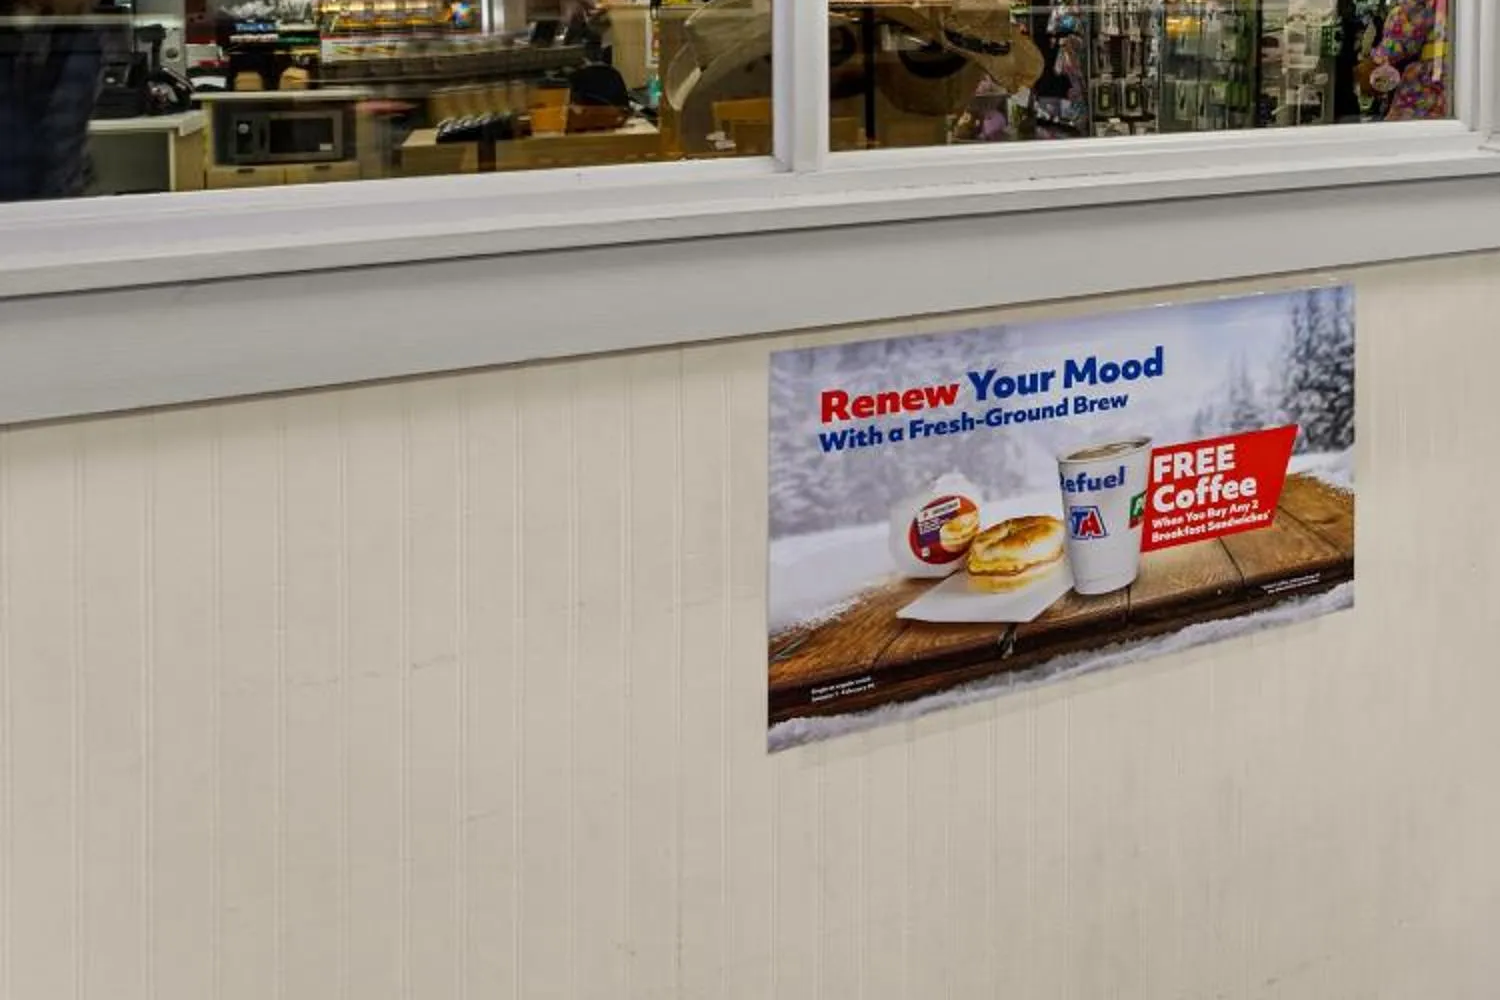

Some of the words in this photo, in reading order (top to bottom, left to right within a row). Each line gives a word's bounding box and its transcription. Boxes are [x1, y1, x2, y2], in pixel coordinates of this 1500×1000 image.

[821, 384, 960, 424] Renew
[967, 368, 1056, 402] Your
[1063, 346, 1164, 389] Mood
[819, 424, 883, 452] With
[888, 427, 904, 442] a
[908, 397, 1069, 440] Fresh-Ground
[1073, 394, 1129, 415] Brew
[1153, 443, 1236, 483] FREE
[1152, 475, 1257, 513] Coffee
[1070, 507, 1105, 538] TA
[1151, 515, 1185, 530] When
[1185, 510, 1206, 523] You
[1206, 506, 1229, 519] Buy
[1228, 502, 1251, 515] Any
[1151, 523, 1207, 543] Breakfast
